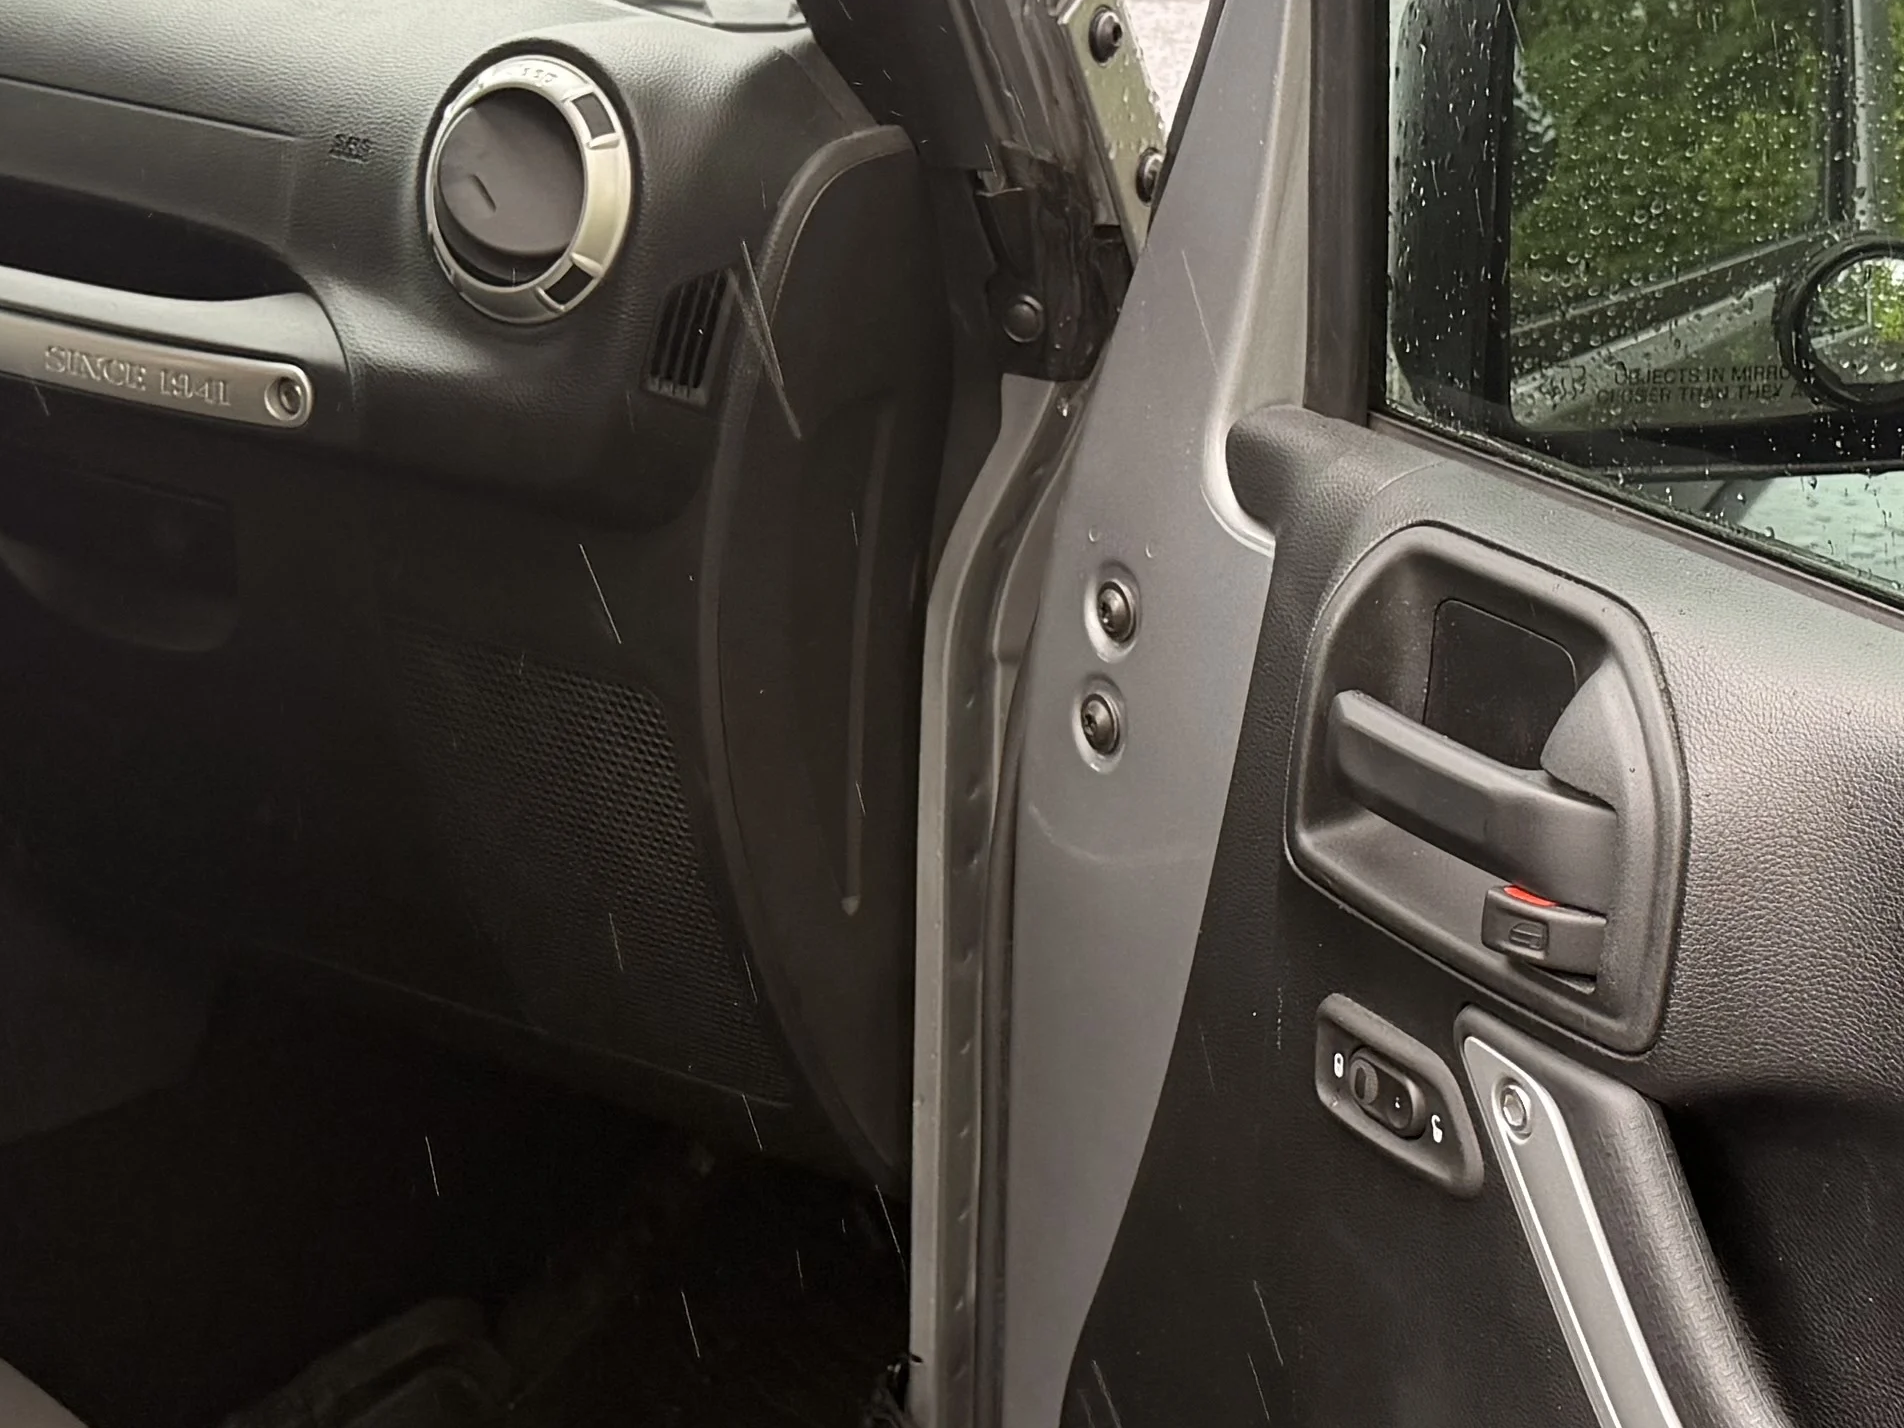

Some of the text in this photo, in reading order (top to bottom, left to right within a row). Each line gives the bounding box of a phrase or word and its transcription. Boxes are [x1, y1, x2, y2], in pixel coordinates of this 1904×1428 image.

[44, 345, 232, 407] SINCE 1941
[1614, 364, 1792, 385] OBJECTS IN MIRRO
[1679, 384, 1729, 401] THAN
[1738, 382, 1784, 399] THEY
